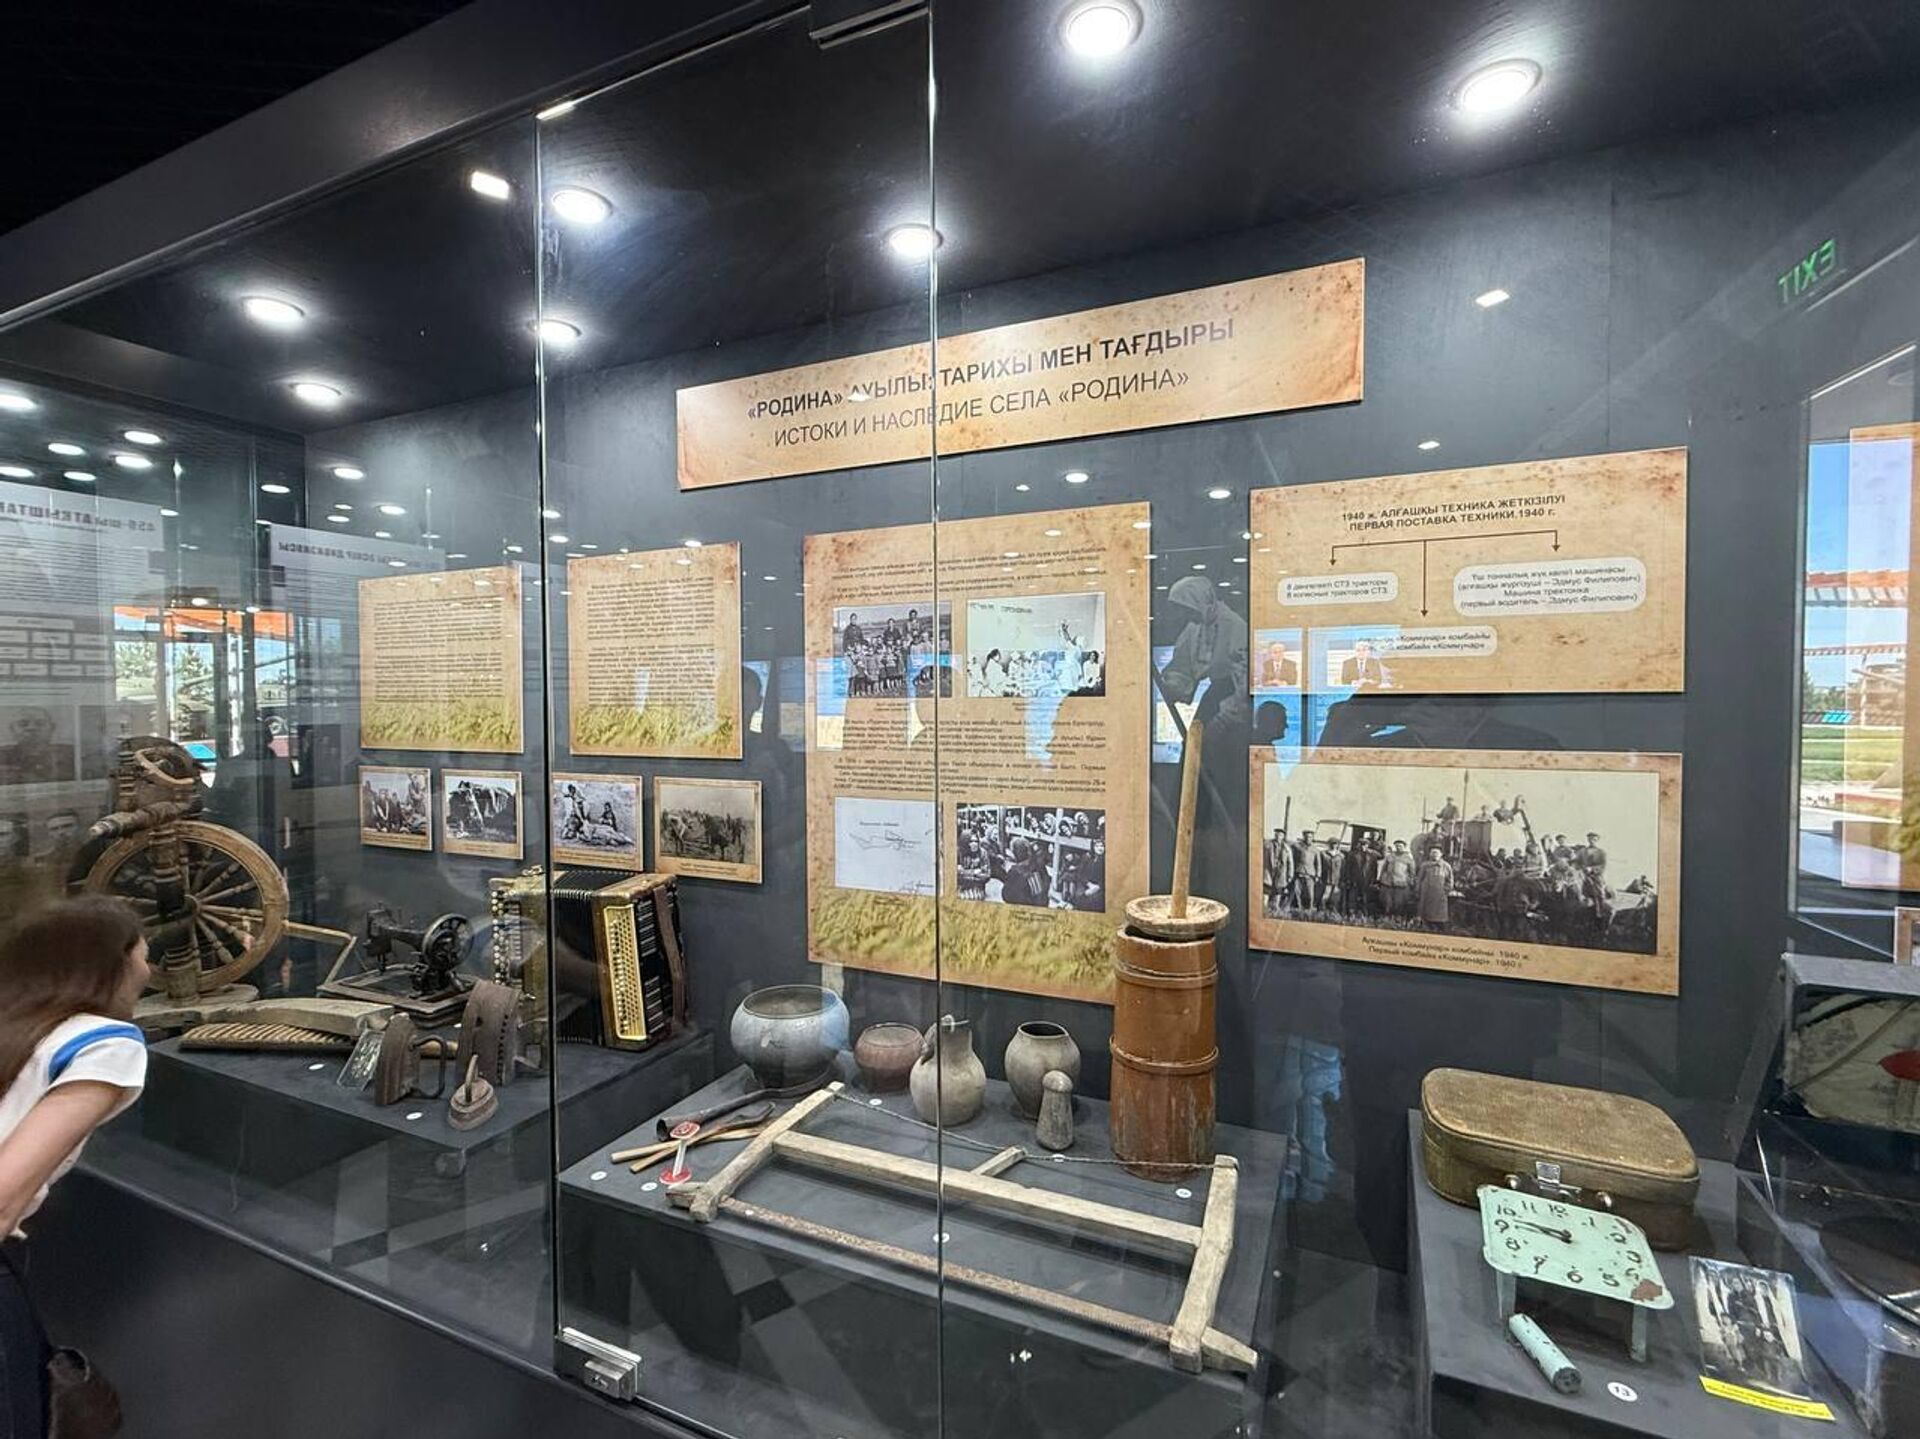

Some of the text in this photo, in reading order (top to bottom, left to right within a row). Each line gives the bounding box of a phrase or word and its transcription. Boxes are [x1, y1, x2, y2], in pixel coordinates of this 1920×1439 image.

[747, 390, 843, 419] «РОДИНА»
[940, 353, 1032, 387] ТАРИХЫ
[1040, 342, 1091, 370] МЕН
[1100, 318, 1234, 360] ТАҒДЫРЫ
[774, 367, 1190, 447] ИСТОКИ И НАСЛЕДИЕ СЕЛА «РОДИНА»
[1343, 512, 1365, 521] 1940
[1381, 505, 1438, 518] АЛҒАШҚЫ
[1441, 500, 1495, 513] ТЕХНИКА
[1349, 520, 1393, 531] ПЕРВАЯ
[1396, 515, 1457, 527] ПОСТАВКА
[1519, 507, 1545, 518] 1940
[1496, 1204, 1516, 1217] 10
[1521, 1200, 1537, 1214] 11
[1505, 1237, 1520, 1251] 8
[1567, 1269, 1584, 1284] 6
